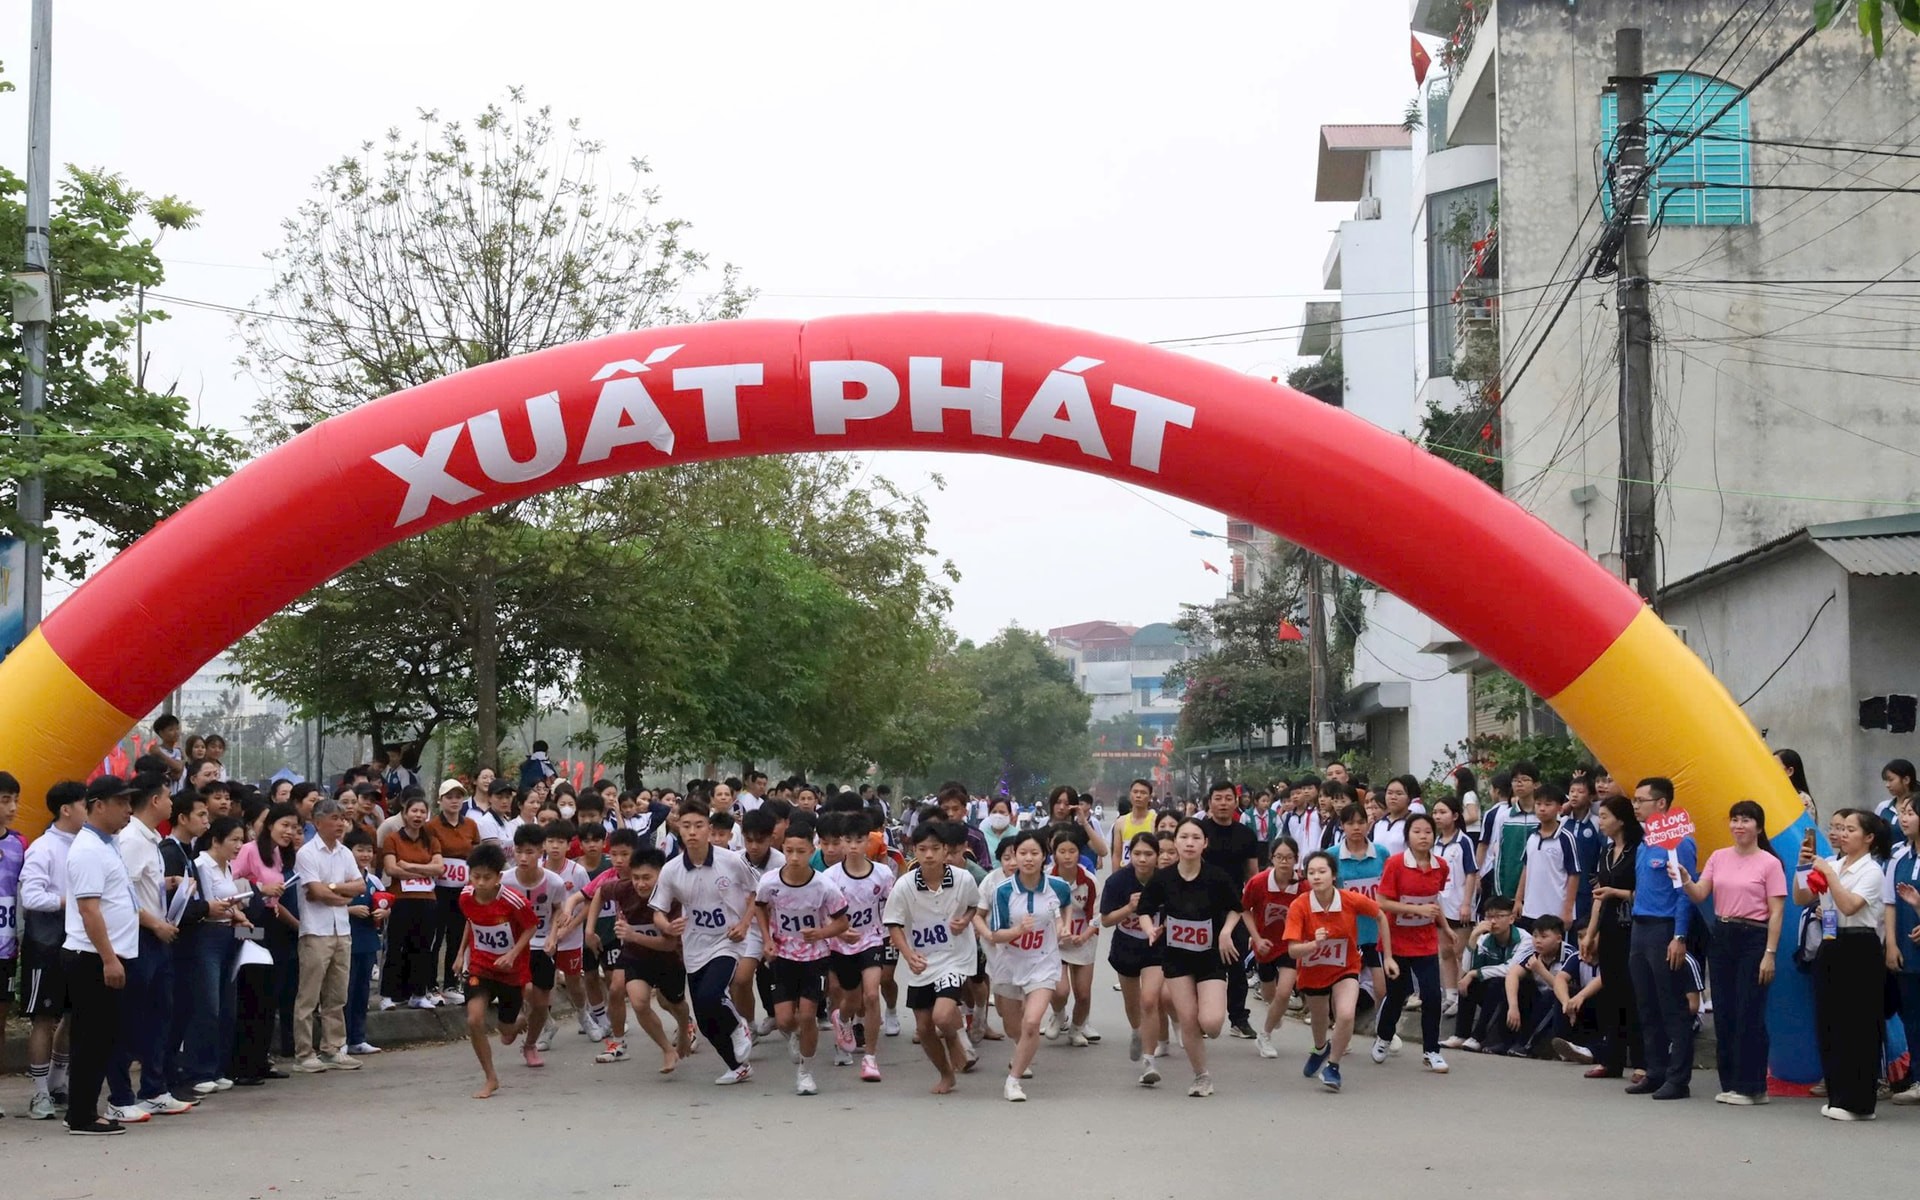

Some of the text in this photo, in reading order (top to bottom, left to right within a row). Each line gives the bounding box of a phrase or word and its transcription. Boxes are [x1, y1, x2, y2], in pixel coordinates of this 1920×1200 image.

[371, 344, 1196, 527] XUẤT PHÁT
[1647, 812, 1687, 831] WE LOVE
[438, 864, 466, 882] 249
[692, 908, 726, 929] 226
[780, 914, 816, 932] 219
[847, 908, 873, 929] 23
[1121, 916, 1143, 932] 22
[475, 930, 509, 949] 243
[912, 925, 948, 948] 248
[1172, 925, 1208, 946] 226
[1309, 943, 1342, 962] 241
